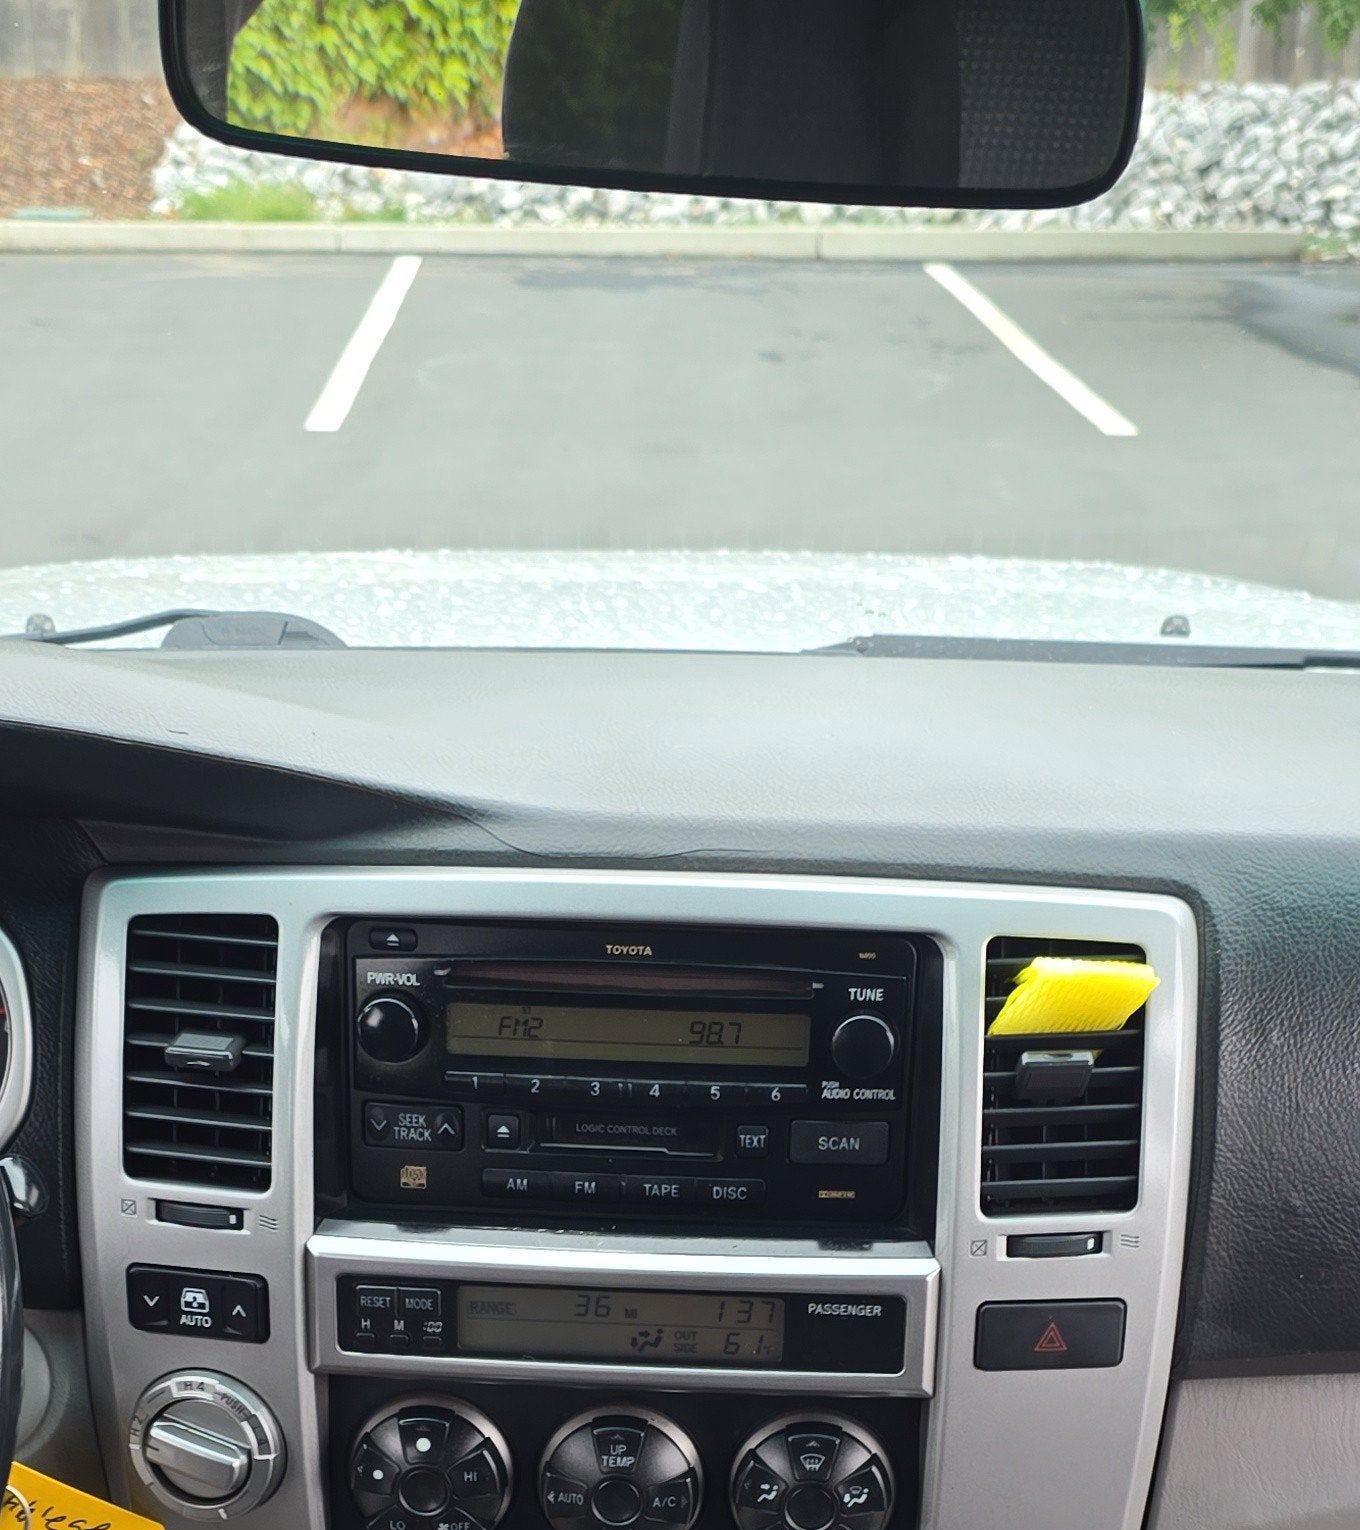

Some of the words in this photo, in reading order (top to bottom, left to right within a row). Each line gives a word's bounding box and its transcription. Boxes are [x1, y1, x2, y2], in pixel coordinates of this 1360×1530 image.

[605, 944, 653, 956] TOYOTA
[848, 987, 884, 1002] TUNE
[498, 1015, 544, 1039] FM2
[470, 1076, 479, 1090] 1
[529, 1079, 541, 1094] 2
[589, 1081, 601, 1096] 3
[648, 1083, 661, 1098] 4
[710, 1085, 721, 1101] 5
[770, 1086, 782, 1101] 6
[821, 1088, 851, 1099] AUDIO
[853, 1088, 896, 1100] CONTROL
[398, 1113, 427, 1127] SEEK
[393, 1127, 432, 1142] TRACK
[575, 1123, 605, 1134] LOGIC
[607, 1124, 651, 1135] CONTROL
[652, 1126, 678, 1136] DECK
[739, 1135, 766, 1148] TEXT
[818, 1137, 860, 1151] SCAN
[506, 1178, 528, 1191] AM
[574, 1181, 596, 1195] FM
[643, 1183, 680, 1197] TAPE
[712, 1186, 748, 1200] DISC
[360, 1296, 391, 1308] RESET
[405, 1298, 433, 1310] MODE
[470, 1303, 514, 1315] RANGE
[574, 1294, 611, 1317] 36
[808, 1303, 882, 1317] PASSENGER
[180, 1315, 212, 1328] AUTO
[361, 1318, 371, 1330] H
[393, 1320, 405, 1331] M
[674, 1330, 698, 1341] OUT
[610, 1444, 627, 1456] UP
[601, 1456, 635, 1468] TEMP
[463, 1471, 477, 1482] HI
[558, 1493, 584, 1505] AUTO
[652, 1496, 676, 1508] A/C
